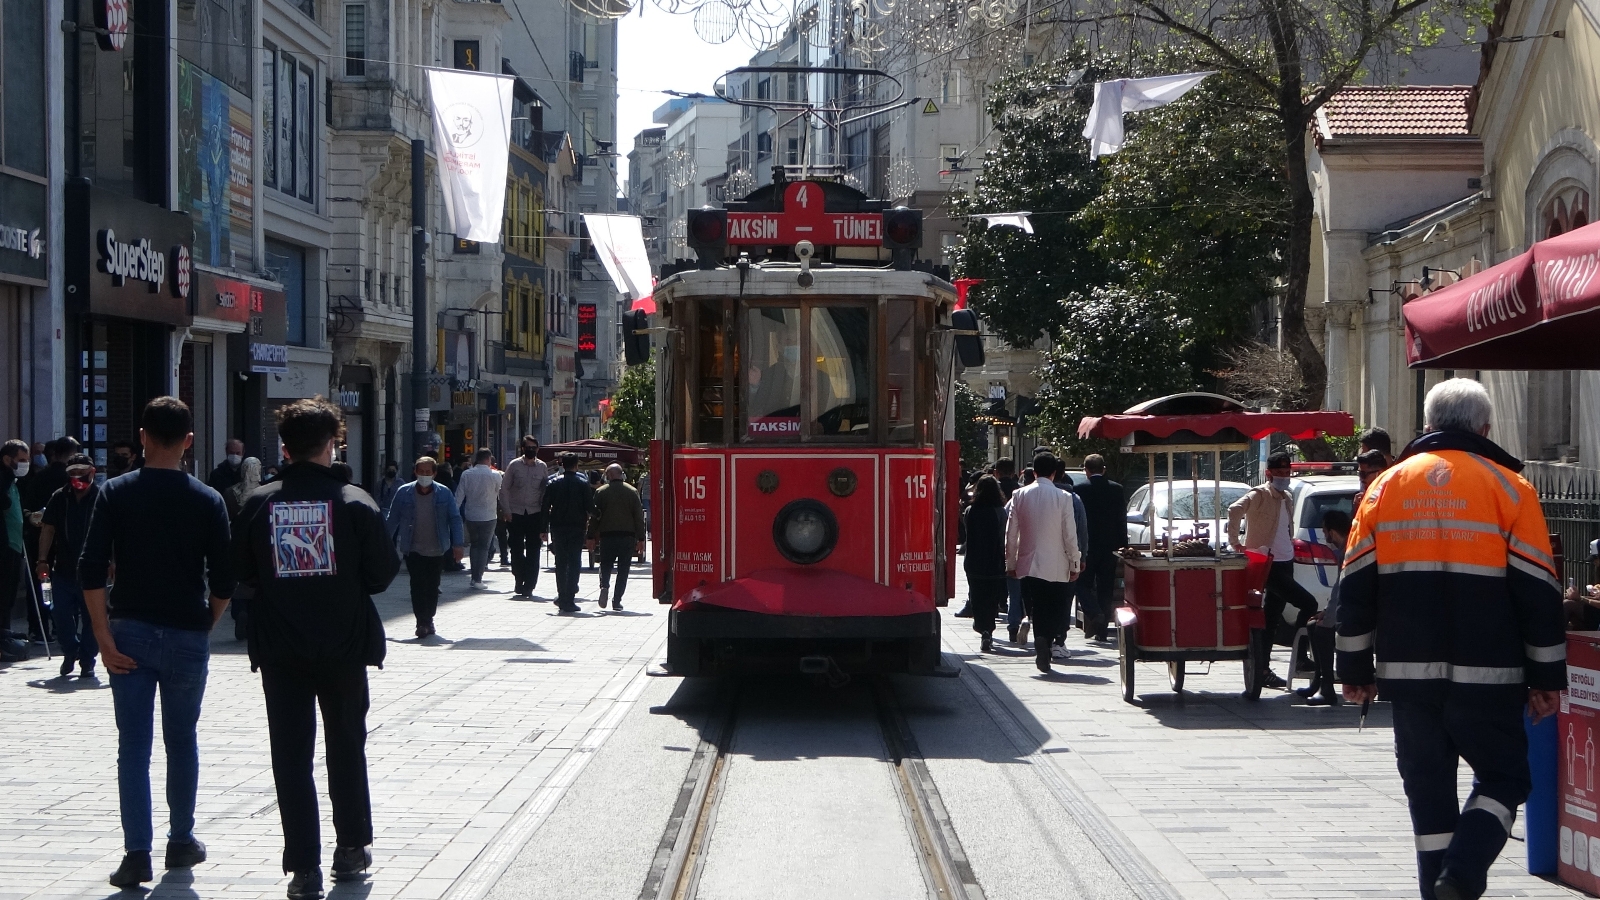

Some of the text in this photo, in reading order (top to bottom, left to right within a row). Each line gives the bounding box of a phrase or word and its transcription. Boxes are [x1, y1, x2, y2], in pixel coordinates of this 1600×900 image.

[796, 185, 808, 208] 4
[833, 216, 883, 240] TÜNEL
[106, 228, 165, 293] SuperStep
[1466, 273, 1526, 332] BEYOĞLU
[750, 420, 801, 432] TAKSİM
[684, 476, 706, 499] 115
[905, 474, 927, 499] 115
[1403, 498, 1468, 510] BÜYÜKŞEHİR
[275, 508, 323, 523] PUMA
[692, 551, 712, 562] YASAK
[897, 563, 906, 573] VE
[1571, 673, 1595, 687] BEYOĞLU
